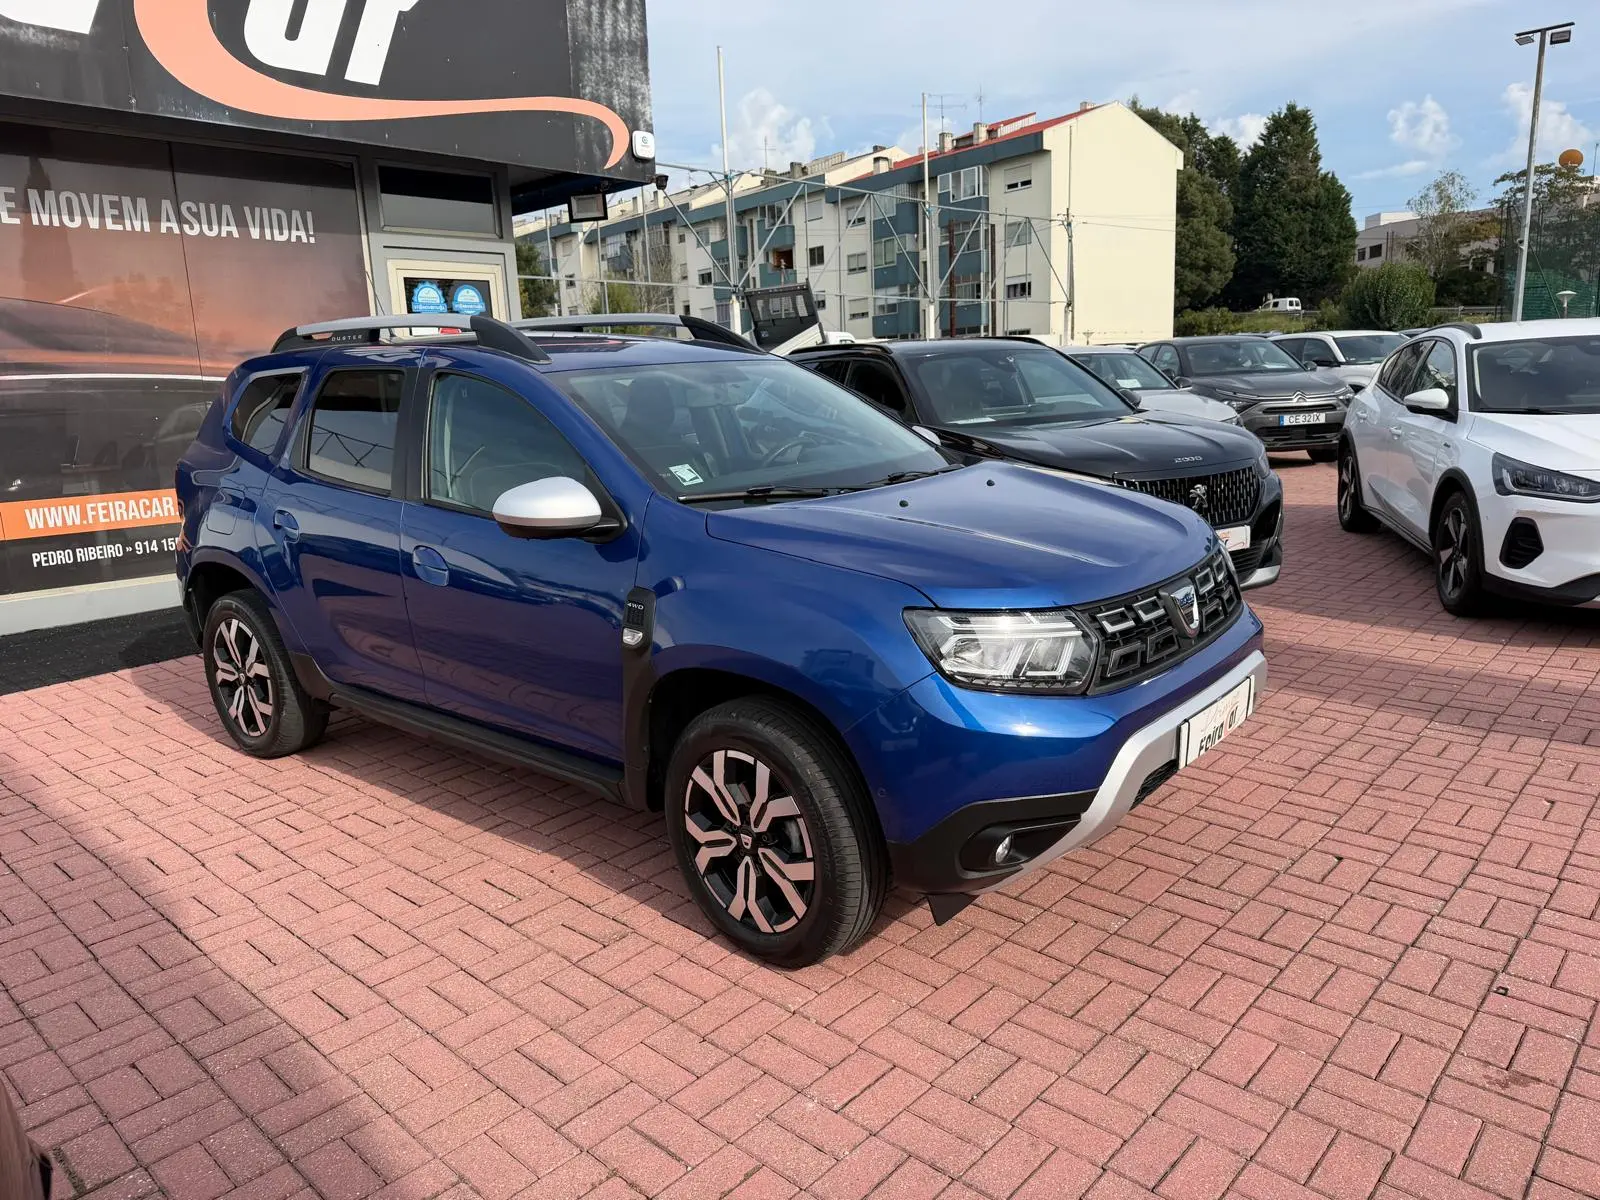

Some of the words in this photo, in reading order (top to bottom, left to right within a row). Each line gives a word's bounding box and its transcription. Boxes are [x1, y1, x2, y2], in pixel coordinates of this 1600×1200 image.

[27, 188, 151, 233] MOVEM
[243, 206, 316, 244] VIDA!
[331, 334, 363, 342] DUSTER
[32, 549, 74, 568] PEDRO
[77, 543, 123, 563] RIBEIRO
[135, 539, 158, 555] 914
[627, 602, 644, 610] 4WD
